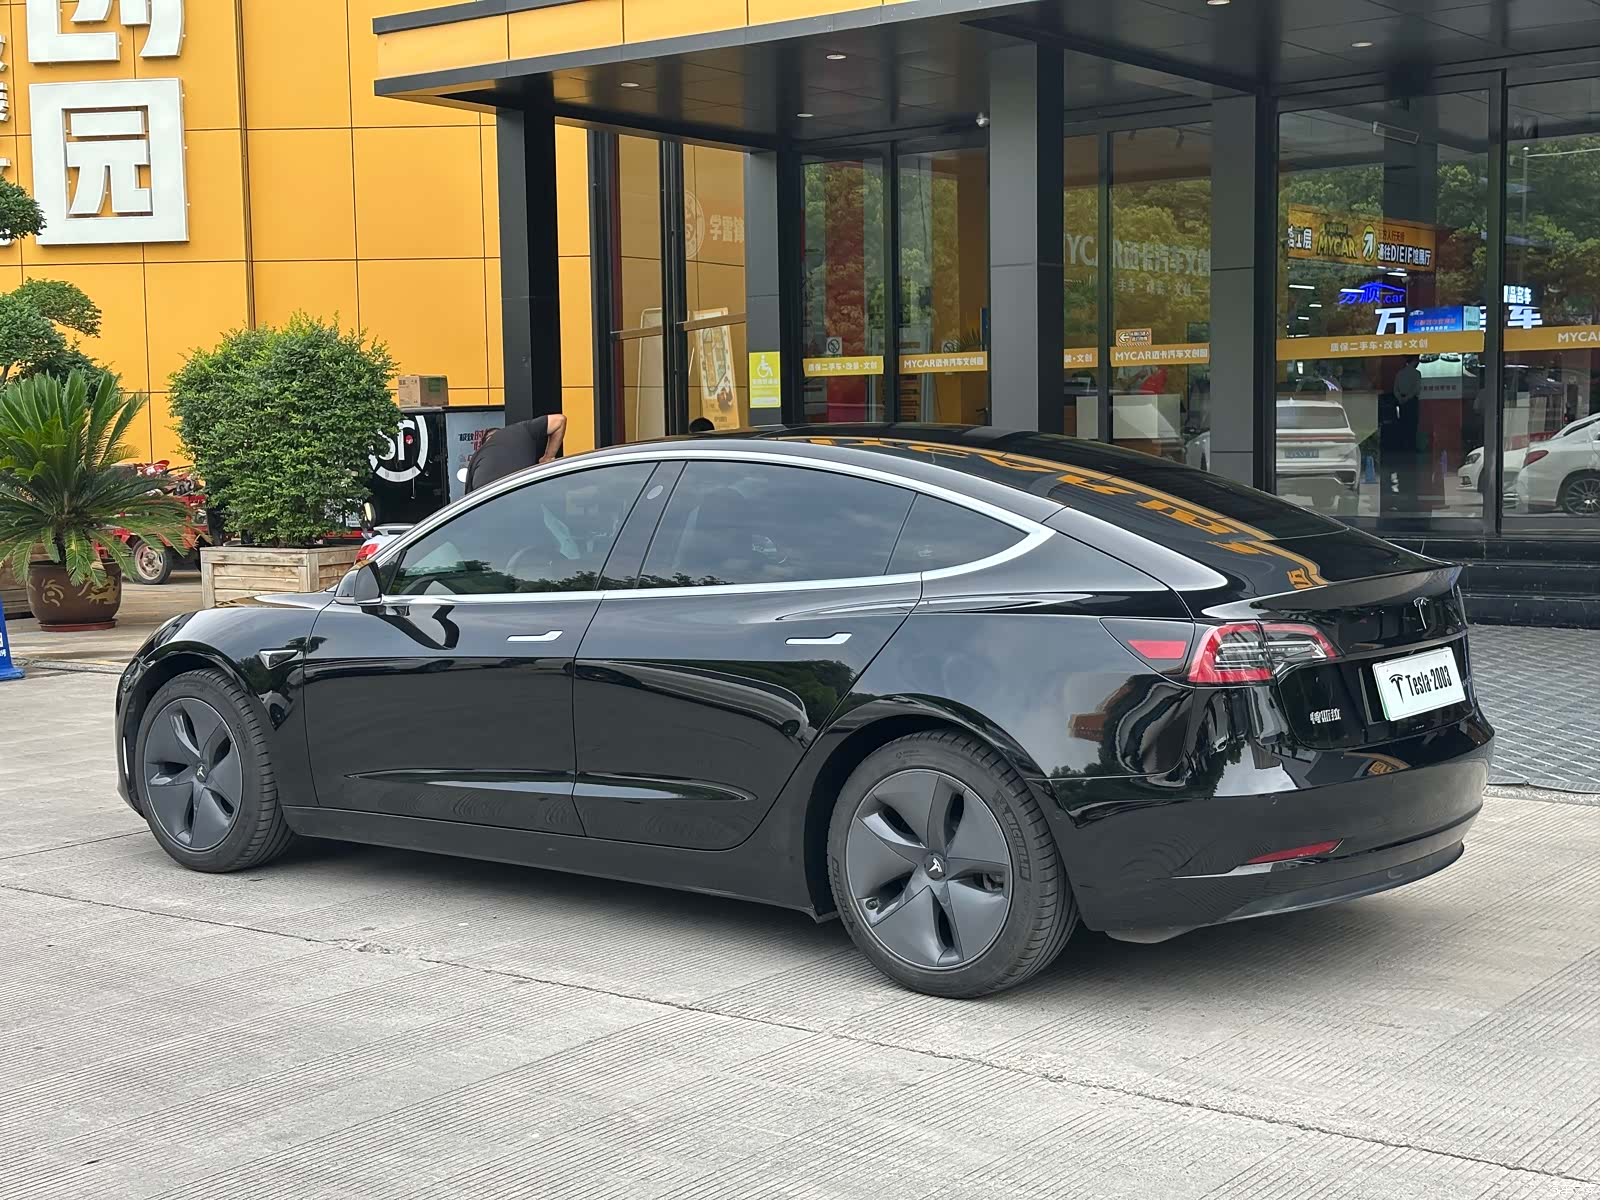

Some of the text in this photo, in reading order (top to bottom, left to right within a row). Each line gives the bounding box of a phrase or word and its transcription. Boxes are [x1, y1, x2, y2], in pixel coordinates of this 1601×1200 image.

[1557, 331, 1601, 344] MYCA
[1309, 707, 1342, 725] 特斯拉
